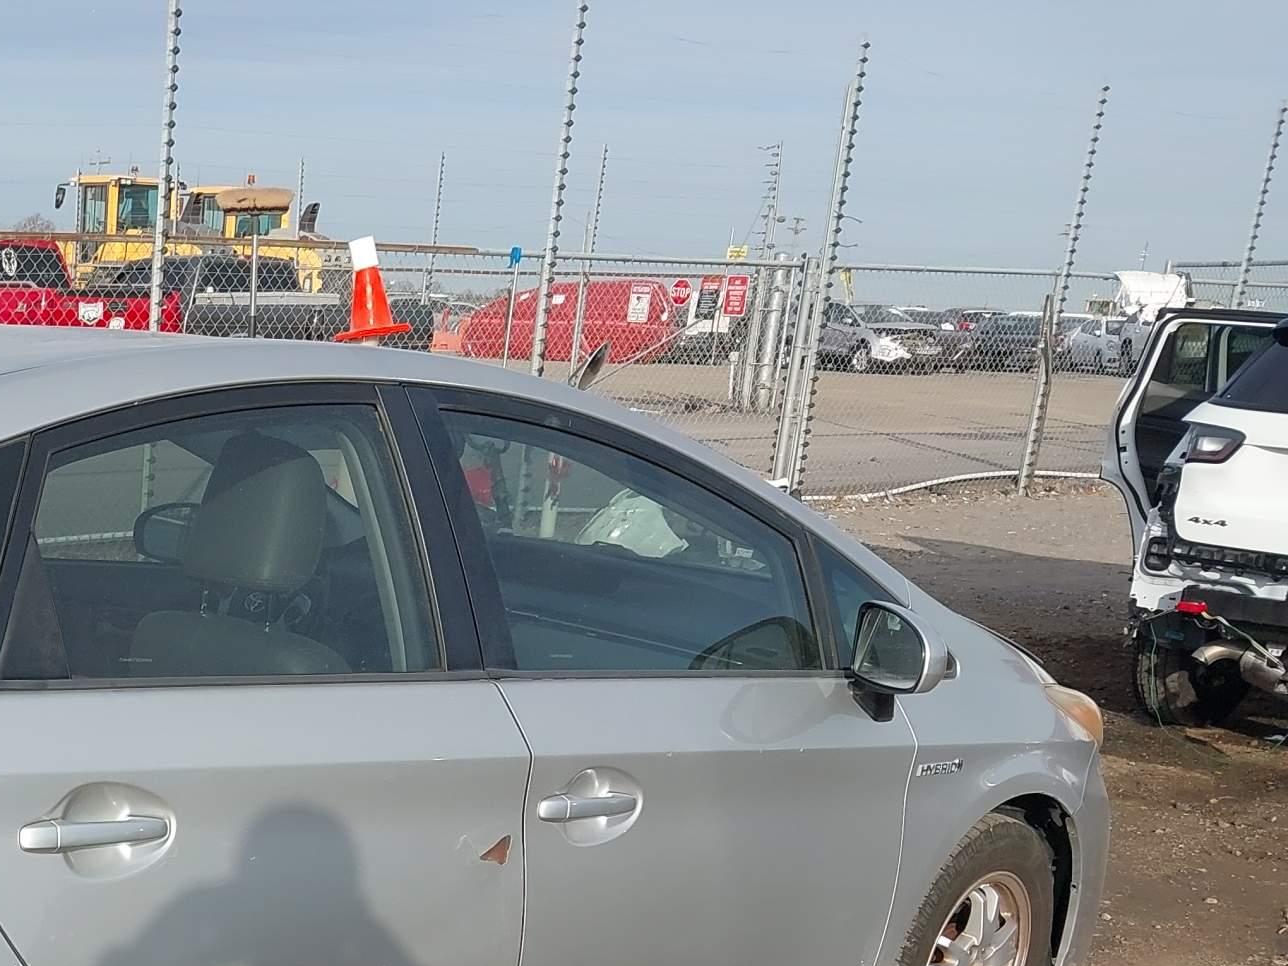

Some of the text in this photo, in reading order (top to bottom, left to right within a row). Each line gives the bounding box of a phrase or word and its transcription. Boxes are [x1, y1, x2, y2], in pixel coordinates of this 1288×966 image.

[672, 286, 691, 298] STOP
[1187, 516, 1228, 527] 4x4
[916, 760, 961, 777] HYBRID
